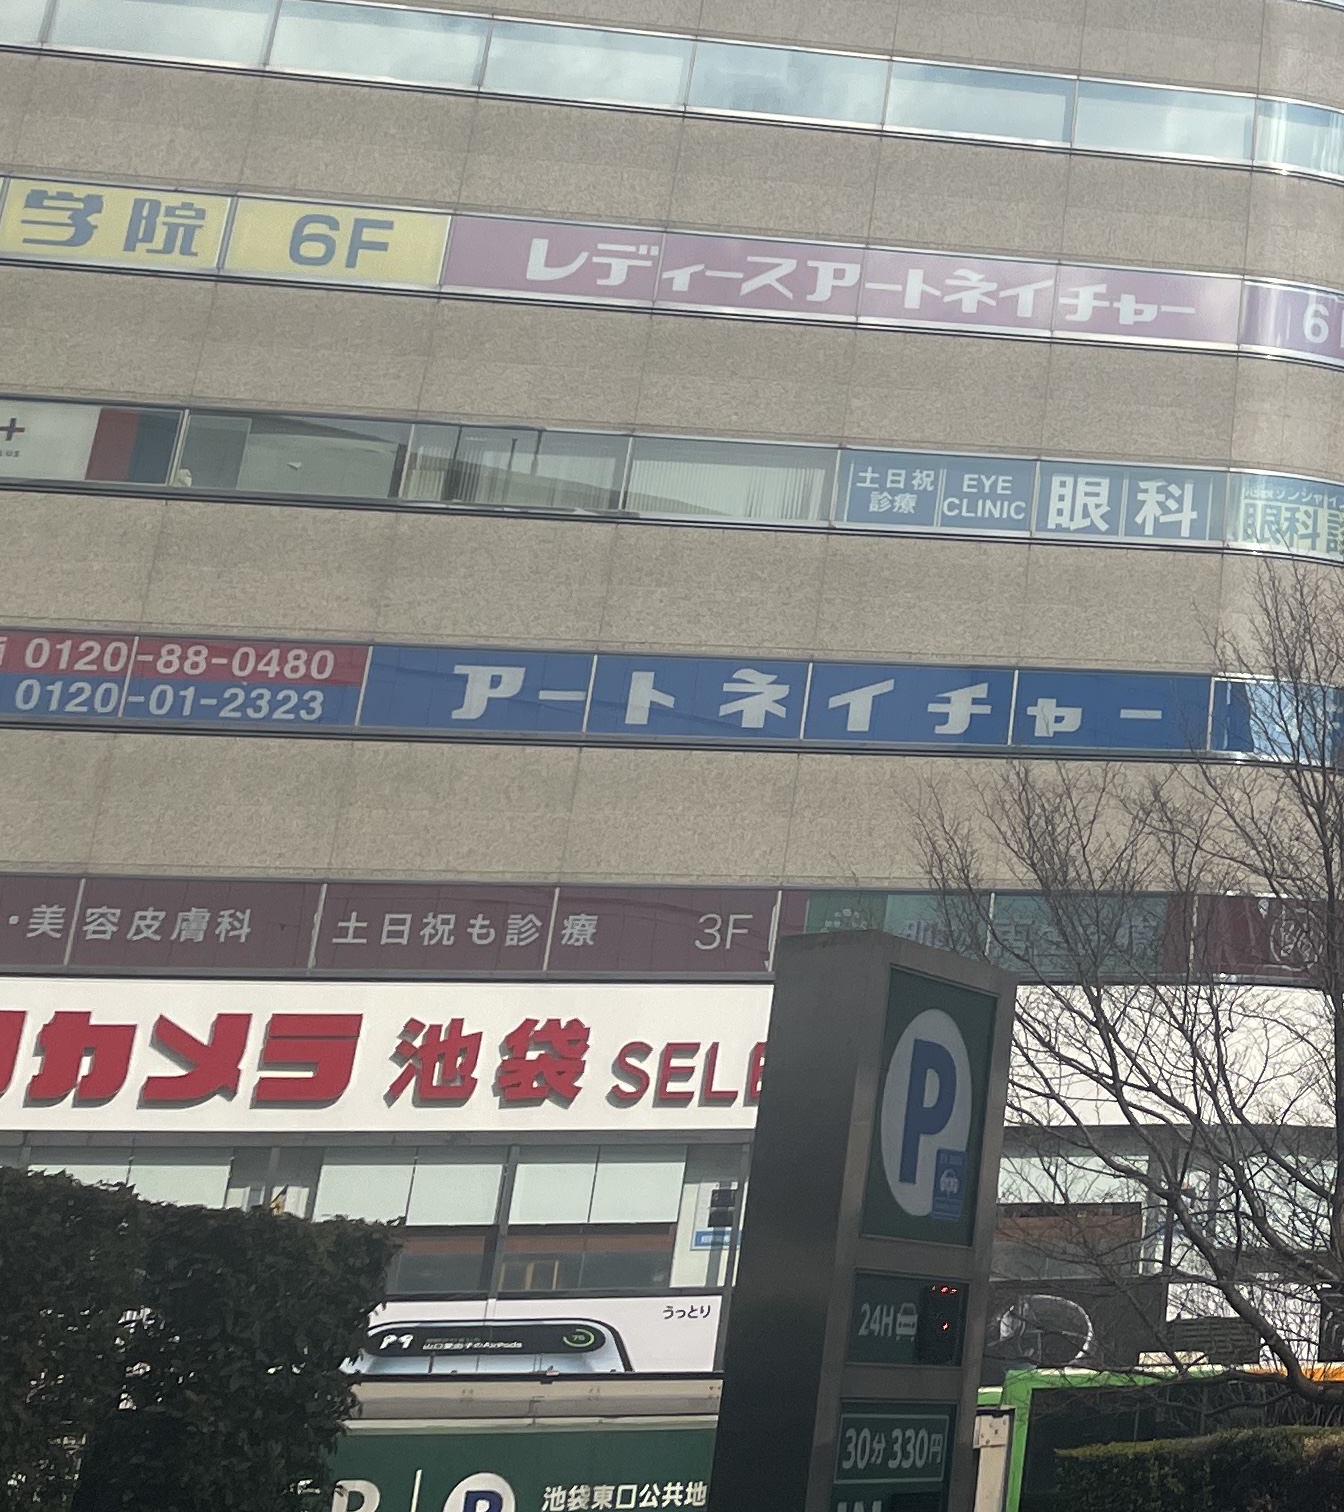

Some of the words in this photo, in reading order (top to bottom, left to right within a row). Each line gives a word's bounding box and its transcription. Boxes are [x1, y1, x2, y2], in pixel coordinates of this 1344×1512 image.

[22, 189, 207, 257] 学院
[289, 213, 394, 268] 6F
[526, 238, 1196, 325] レディースアートネイチャー
[857, 468, 935, 491] 土日祝
[962, 474, 1012, 494] EYE
[869, 491, 917, 515] 診療
[942, 496, 1026, 521] CLINIC
[1047, 475, 1198, 537] 眼科
[25, 637, 336, 679] 0120-88-0480
[15, 678, 324, 720] 0120-01-2323
[451, 664, 1163, 735] アートネイチャー
[332, 909, 599, 947] 土日祝も診療
[694, 913, 754, 952] 3F
[387, 1017, 592, 1105] 池袋
[900, 1038, 957, 1184] P
[662, 1304, 712, 1320] うっとり
[858, 1303, 894, 1338] 24H
[842, 1429, 885, 1470] 30分
[888, 1429, 944, 1470] 330円
[542, 1482, 708, 1512] 池袋東口公共地
